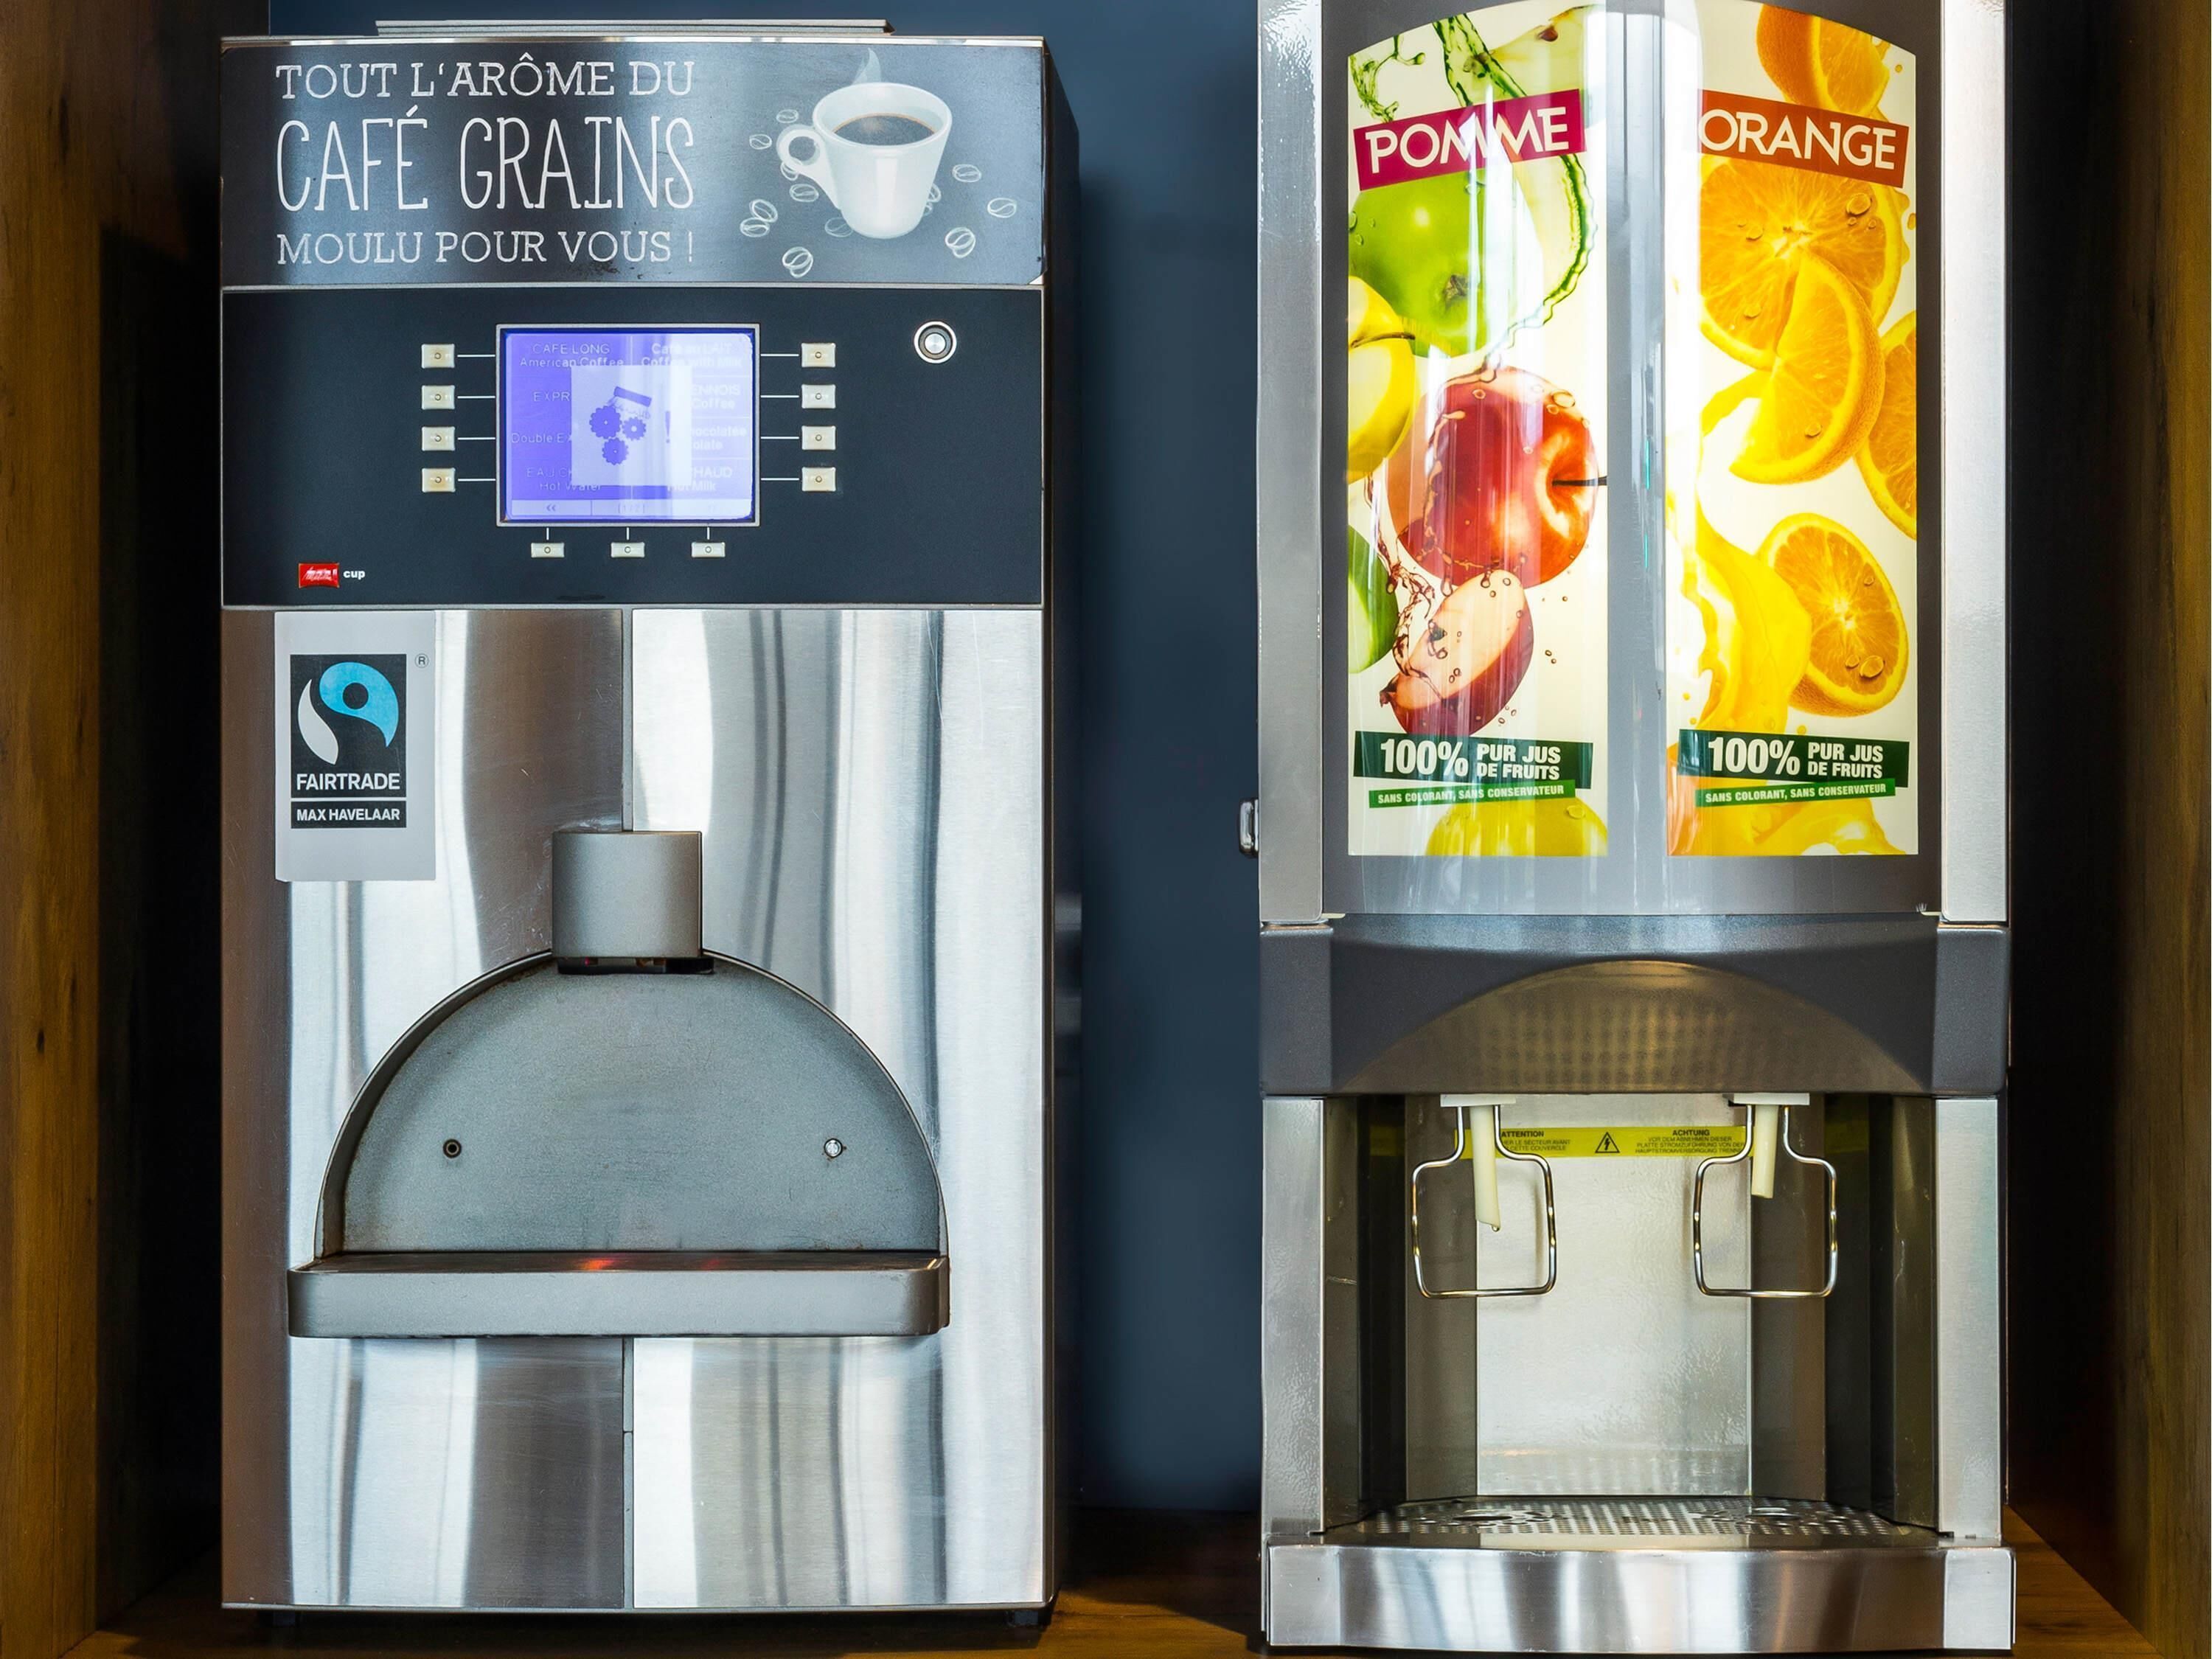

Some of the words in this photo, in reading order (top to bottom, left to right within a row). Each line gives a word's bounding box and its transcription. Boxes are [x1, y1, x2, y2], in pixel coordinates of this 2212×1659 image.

[276, 62, 397, 100] TOUT
[628, 60, 695, 97] DU
[1365, 105, 1570, 175] POMME
[1697, 108, 1896, 171] ORANGE
[277, 104, 429, 212] CAFÉ
[460, 115, 695, 210] GRAINS
[276, 232, 424, 265] MOULU
[435, 231, 548, 264] POUR
[557, 230, 672, 263] VOUS
[686, 230, 694, 263] !
[532, 343, 568, 355] CAFE
[571, 343, 611, 355] LONG
[520, 357, 576, 368] American
[579, 356, 625, 366] Coffee
[533, 391, 571, 402] EXPR
[692, 383, 740, 395] ENNOIS
[511, 433, 553, 443] Double
[692, 438, 723, 450] olate
[692, 467, 732, 478] HAUD
[343, 570, 366, 580] cup
[1380, 737, 1469, 776] 100%
[1476, 743, 1517, 762] PUR
[1521, 745, 1562, 765] JUS
[1708, 736, 1801, 776] 100%
[1808, 742, 1844, 761] PUR
[1849, 744, 1884, 763] JUS
[1476, 762, 1498, 778] DE
[1502, 764, 1560, 781] FRUITS
[1807, 761, 1829, 776] DE
[1832, 762, 1883, 779] FRUITS
[296, 772, 400, 791] FAIRTRADE
[1377, 793, 1402, 804] SANS
[1405, 791, 1457, 803] COLORANT,
[1458, 788, 1485, 800] SANS
[1487, 785, 1565, 799] CONSERVATEUR
[1705, 792, 1732, 804] SANS
[1734, 790, 1788, 802] COLORANT,
[1790, 787, 1815, 799] SANS
[1818, 783, 1887, 797] CONSERVATEUR
[296, 808, 327, 821] MAX
[329, 807, 400, 821] HAVELAAR
